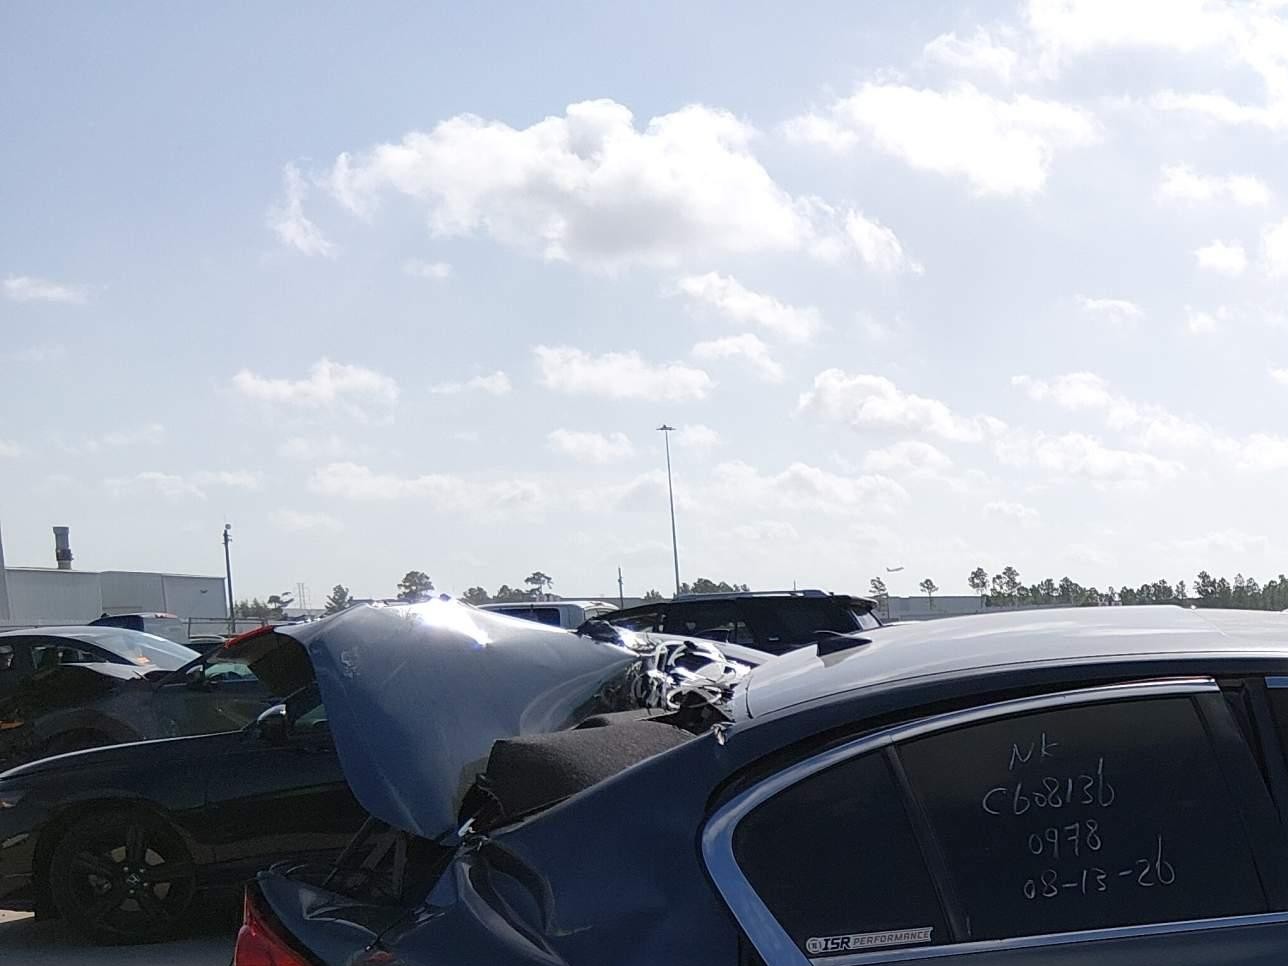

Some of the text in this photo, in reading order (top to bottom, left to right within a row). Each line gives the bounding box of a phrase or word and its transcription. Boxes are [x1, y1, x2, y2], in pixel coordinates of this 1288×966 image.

[1028, 818, 1101, 858] 0978
[1023, 834, 1176, 899] 08-13-26
[822, 931, 929, 951] ISR PERFORMANCE
